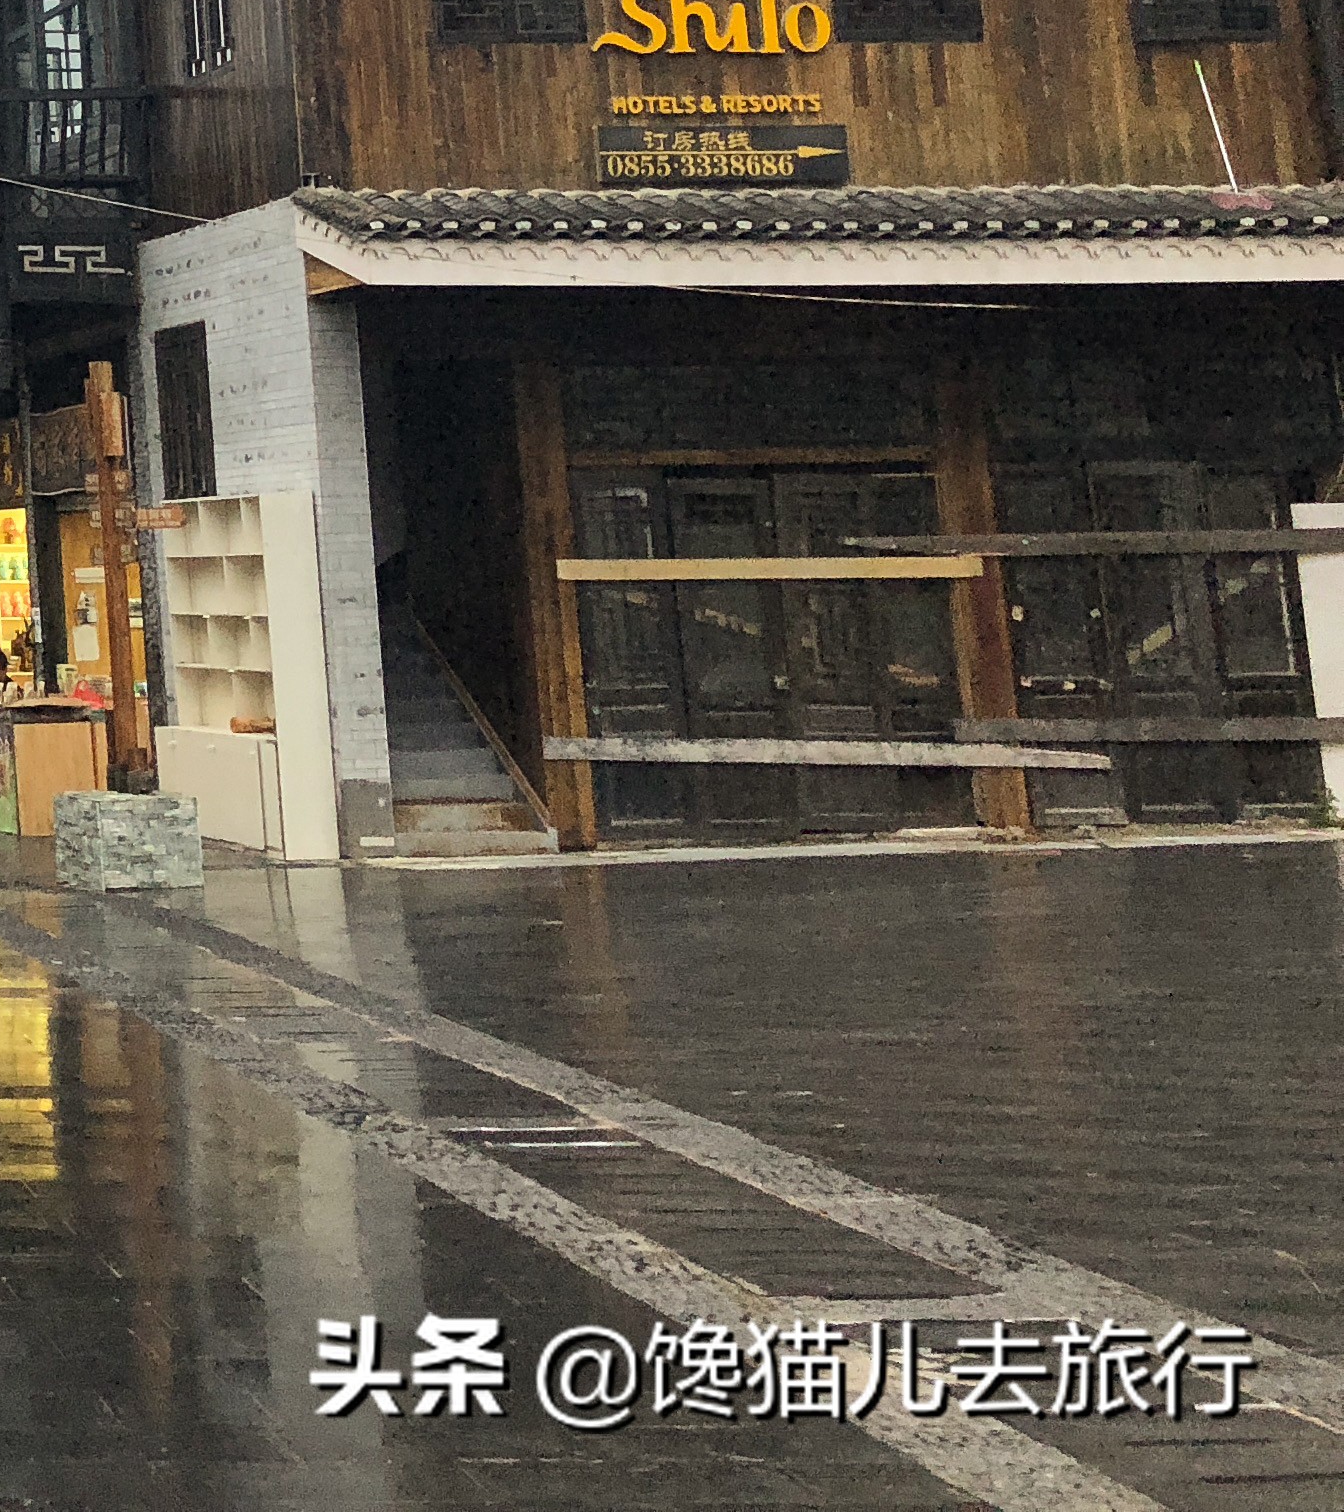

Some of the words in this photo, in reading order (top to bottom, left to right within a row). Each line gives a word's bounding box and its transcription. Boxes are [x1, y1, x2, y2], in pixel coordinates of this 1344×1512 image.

[612, 95, 697, 115] HOTELS
[699, 95, 717, 114] &
[720, 93, 823, 114] RESORTS
[643, 130, 753, 152] 订房热线
